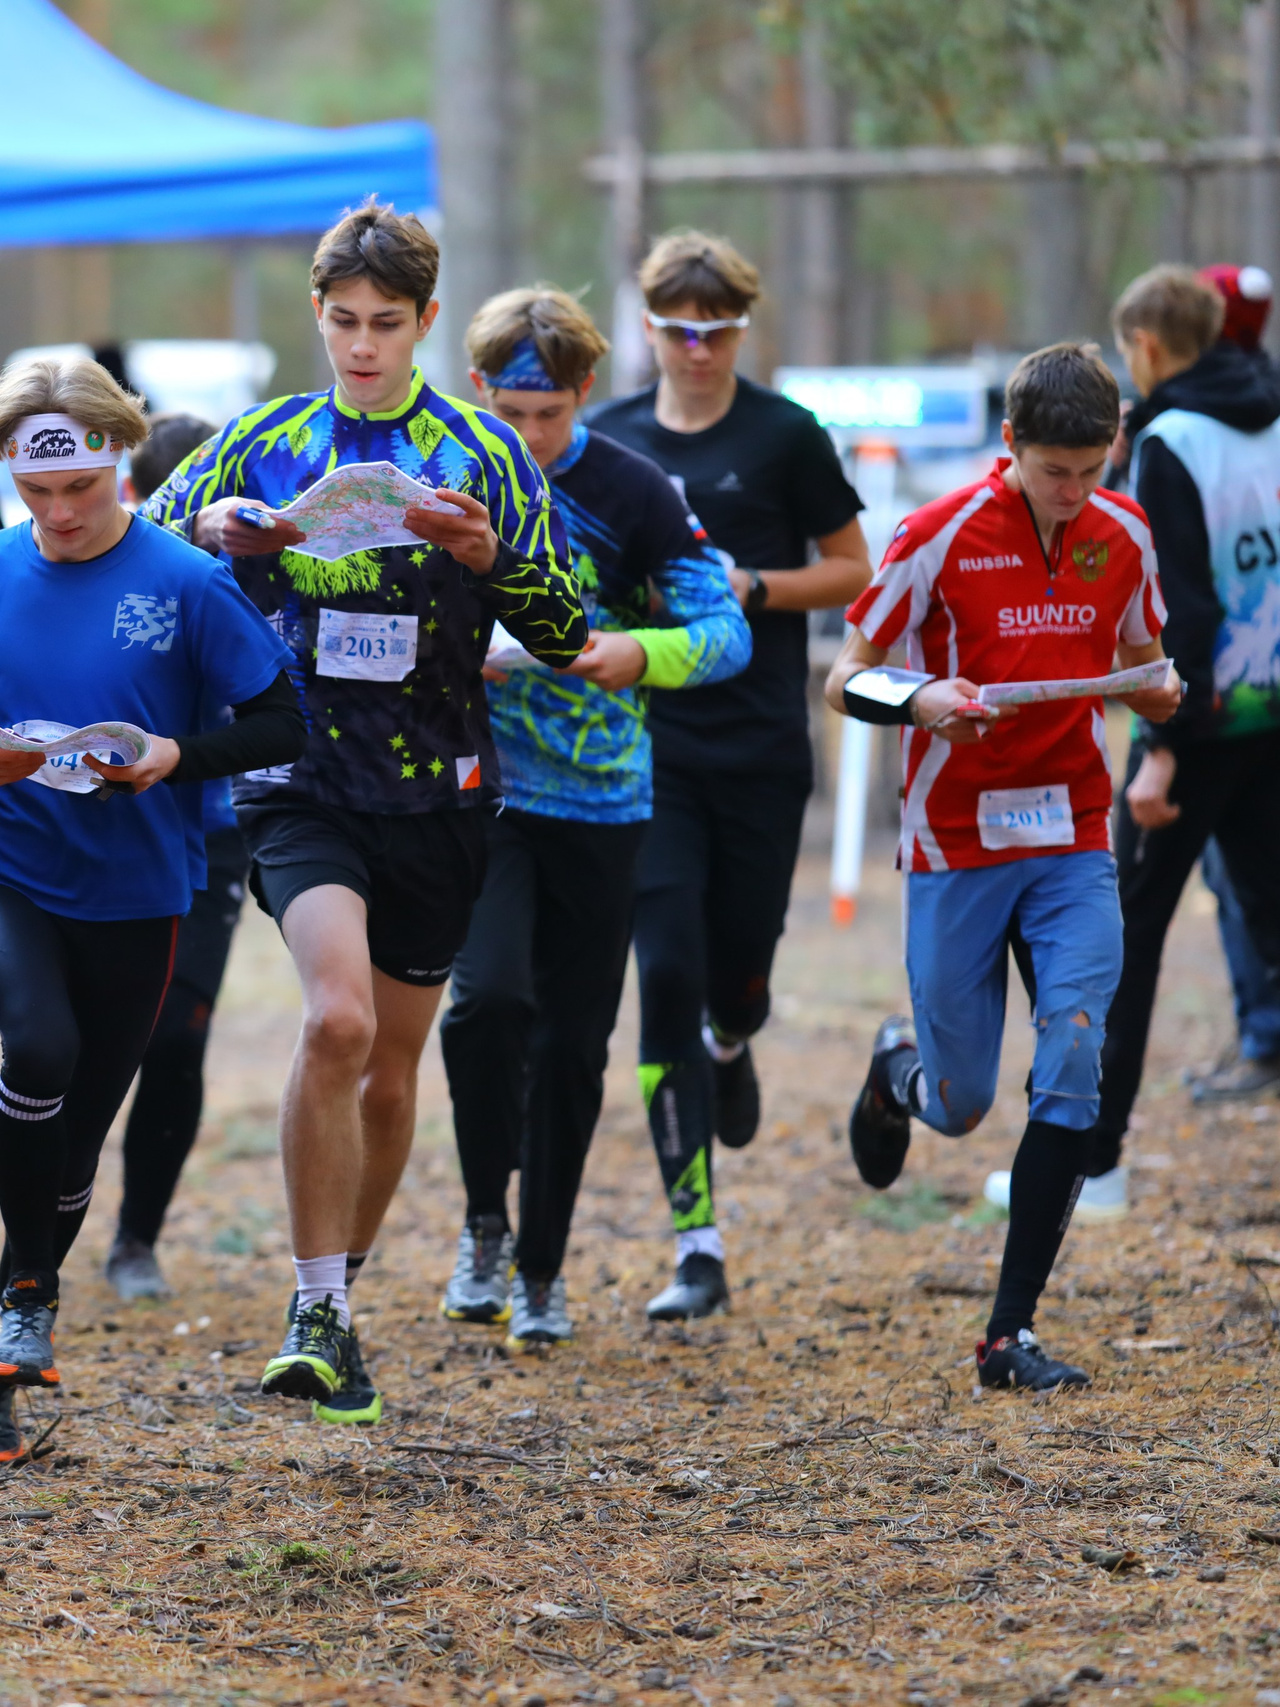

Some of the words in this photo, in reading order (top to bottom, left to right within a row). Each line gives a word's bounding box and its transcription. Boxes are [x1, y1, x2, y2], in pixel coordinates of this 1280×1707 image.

[959, 554, 1023, 572] RUSSIA
[998, 603, 1096, 629] SUUNTO
[345, 635, 386, 659] 203
[50, 753, 77, 771] 04
[1006, 809, 1043, 829] 201
